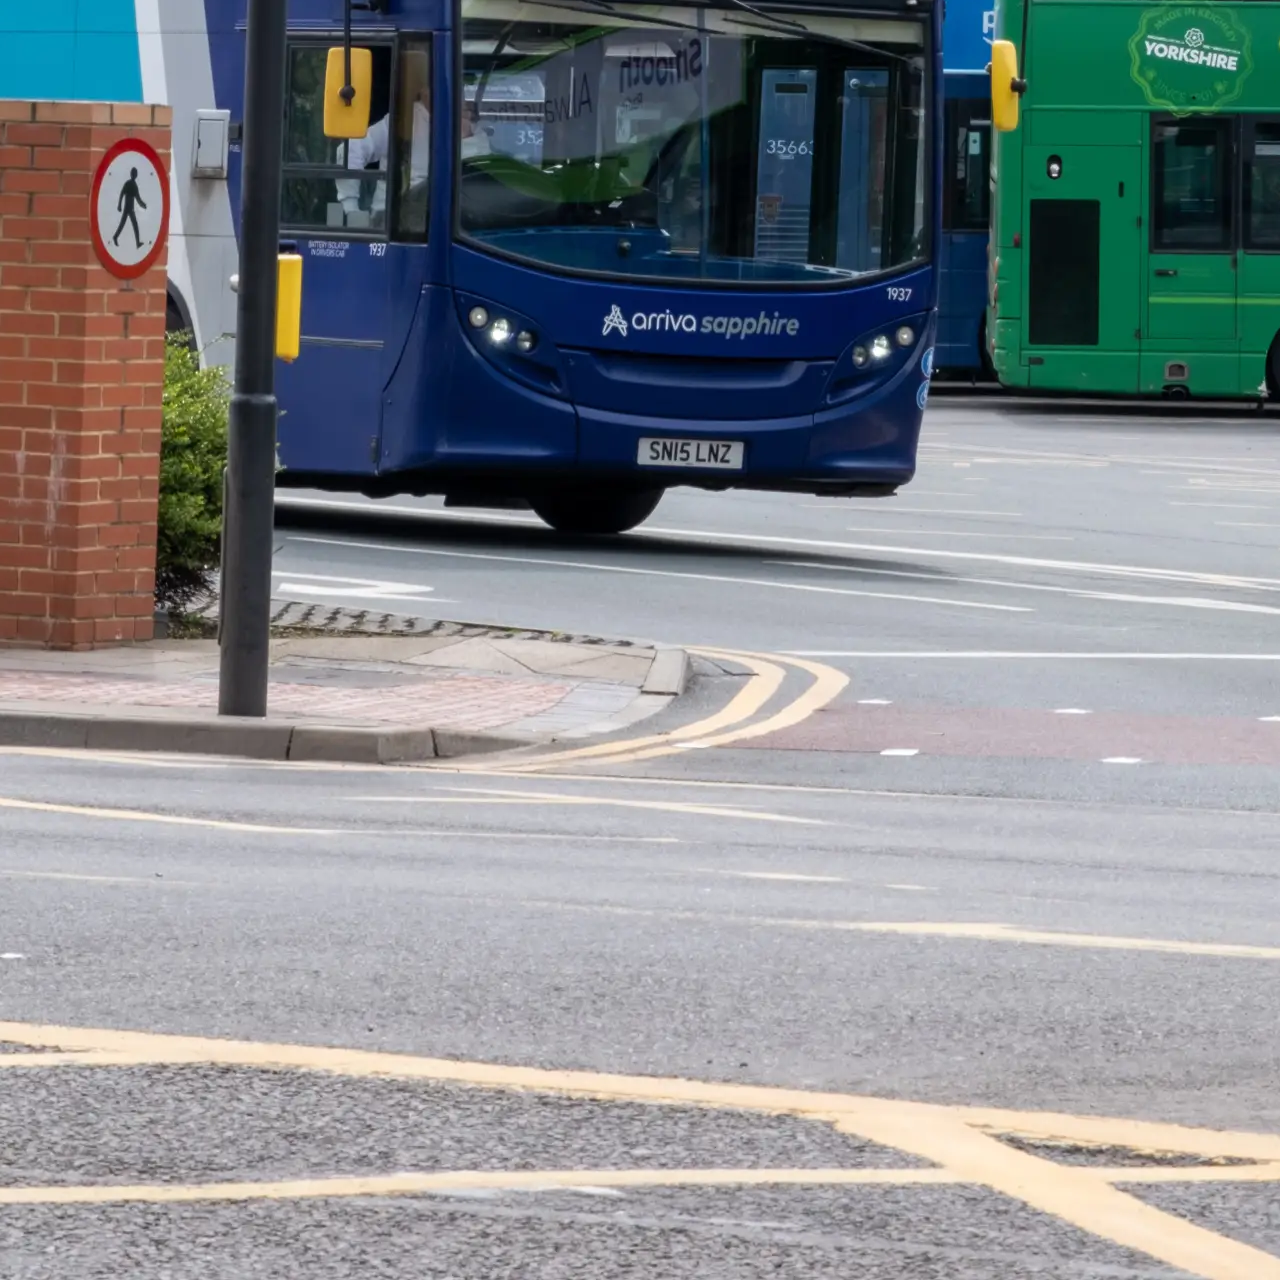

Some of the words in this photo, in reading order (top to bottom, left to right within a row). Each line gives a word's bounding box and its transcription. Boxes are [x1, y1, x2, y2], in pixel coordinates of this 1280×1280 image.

[1144, 40, 1238, 71] YORKSHIRE
[369, 243, 387, 256] 1937
[886, 287, 912, 301] 1937
[632, 309, 696, 331] arriva
[700, 311, 799, 340] sapphire
[649, 441, 691, 462] SN15
[695, 443, 732, 463] LNZ
